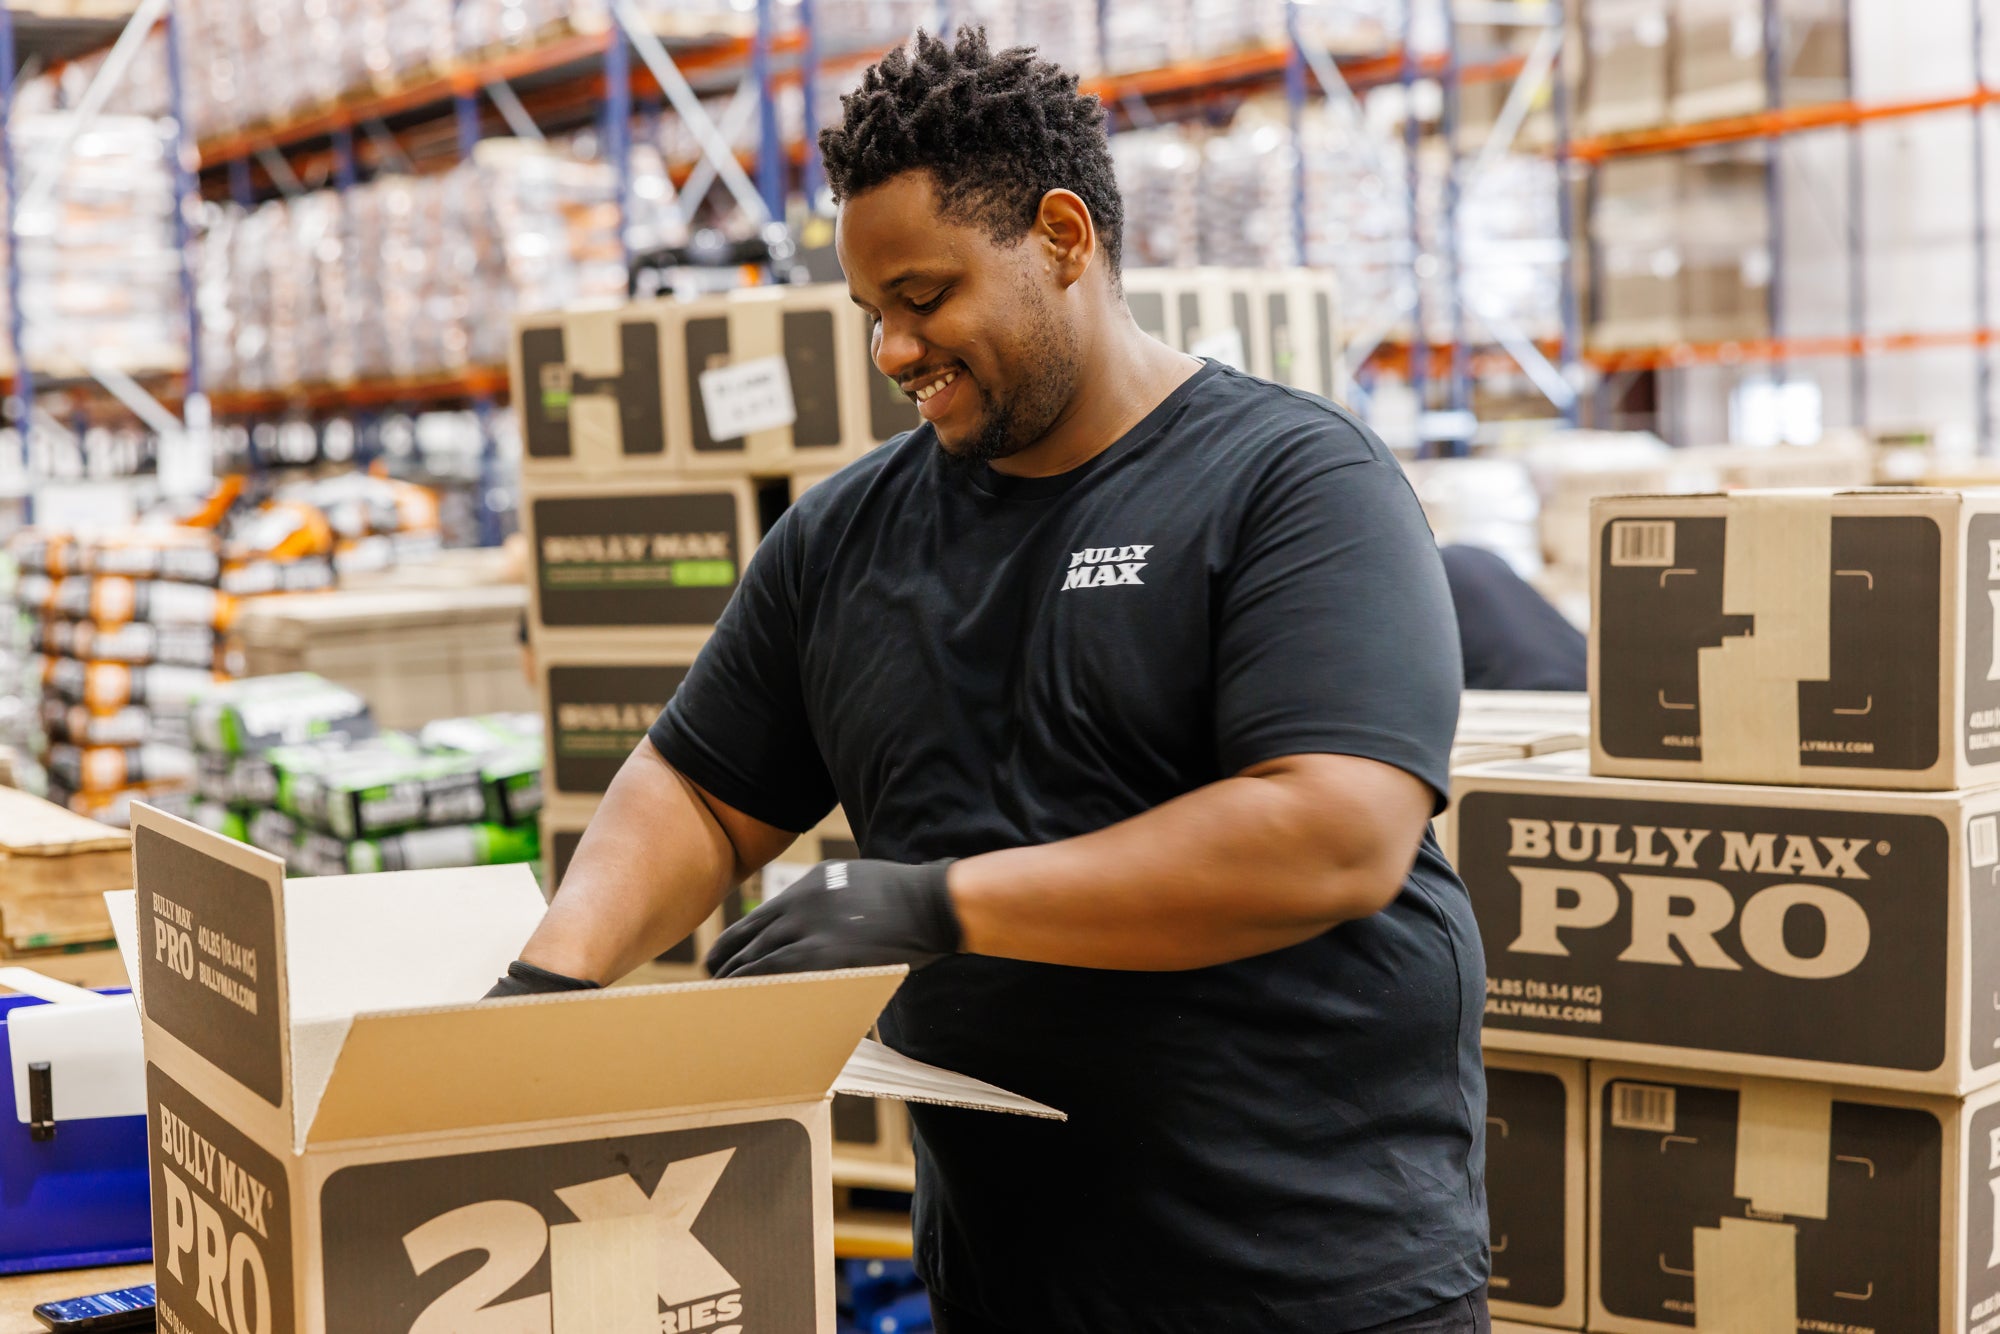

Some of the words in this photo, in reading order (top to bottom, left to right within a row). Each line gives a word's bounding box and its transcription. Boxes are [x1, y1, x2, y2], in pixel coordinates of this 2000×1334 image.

[1060, 562, 1149, 591] MAX
[1506, 817, 1711, 869] BULLY
[152, 891, 175, 921] BULLY
[1506, 865, 1871, 979] PRO
[153, 916, 194, 980] PRO
[199, 961, 258, 1016] BULLYMAX.COM
[1525, 979, 1569, 1000] (18.14
[1571, 985, 1602, 1006] KG)
[159, 1102, 217, 1195] BULLY
[162, 1162, 273, 1334] PRO
